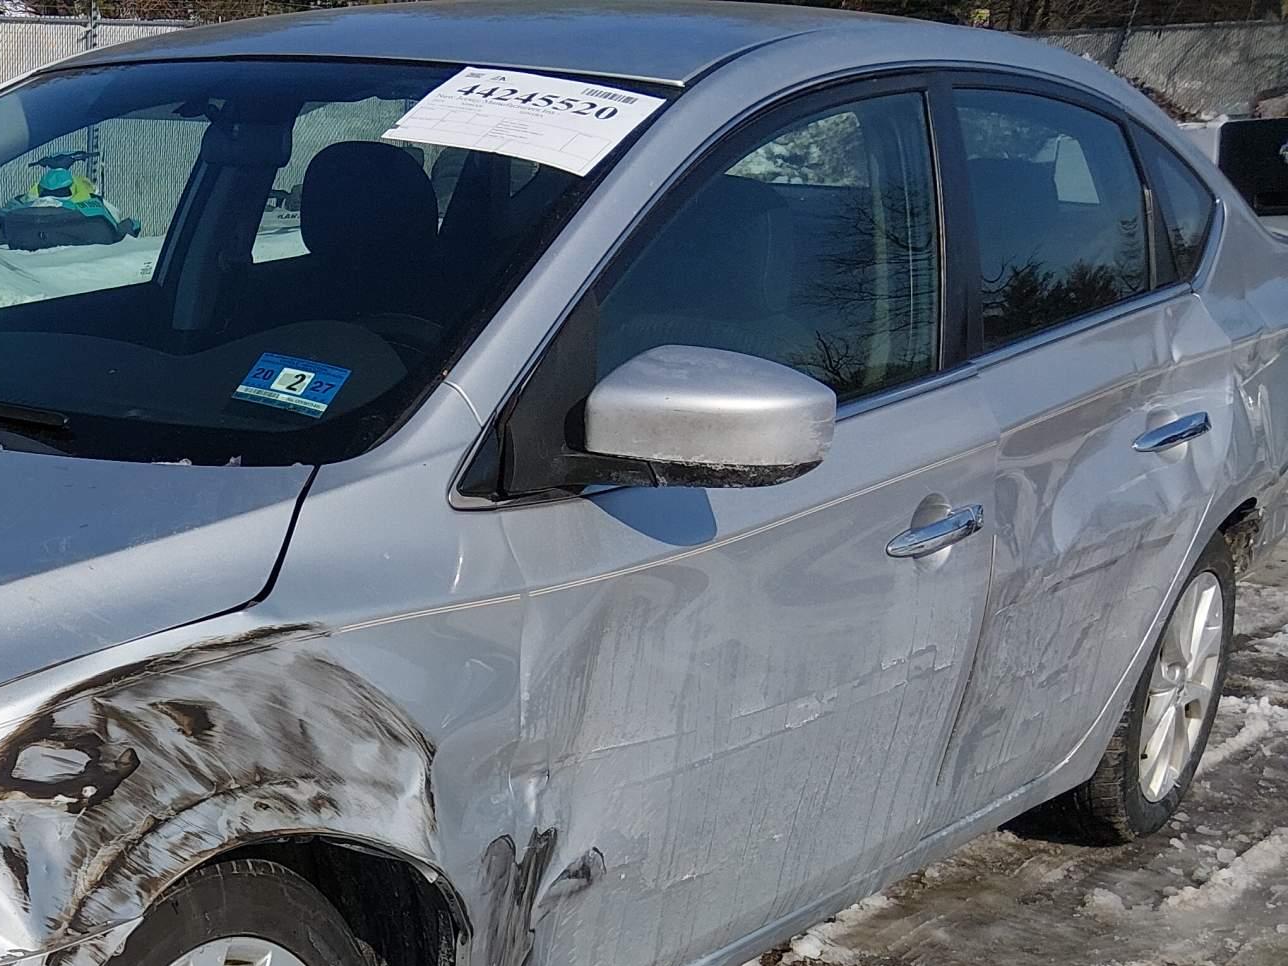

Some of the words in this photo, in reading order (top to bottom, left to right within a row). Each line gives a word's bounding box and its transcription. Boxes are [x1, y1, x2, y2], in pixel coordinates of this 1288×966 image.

[457, 84, 618, 120] 44245520
[253, 368, 275, 381] 20
[286, 373, 306, 391] 2
[311, 380, 336, 393] 27
